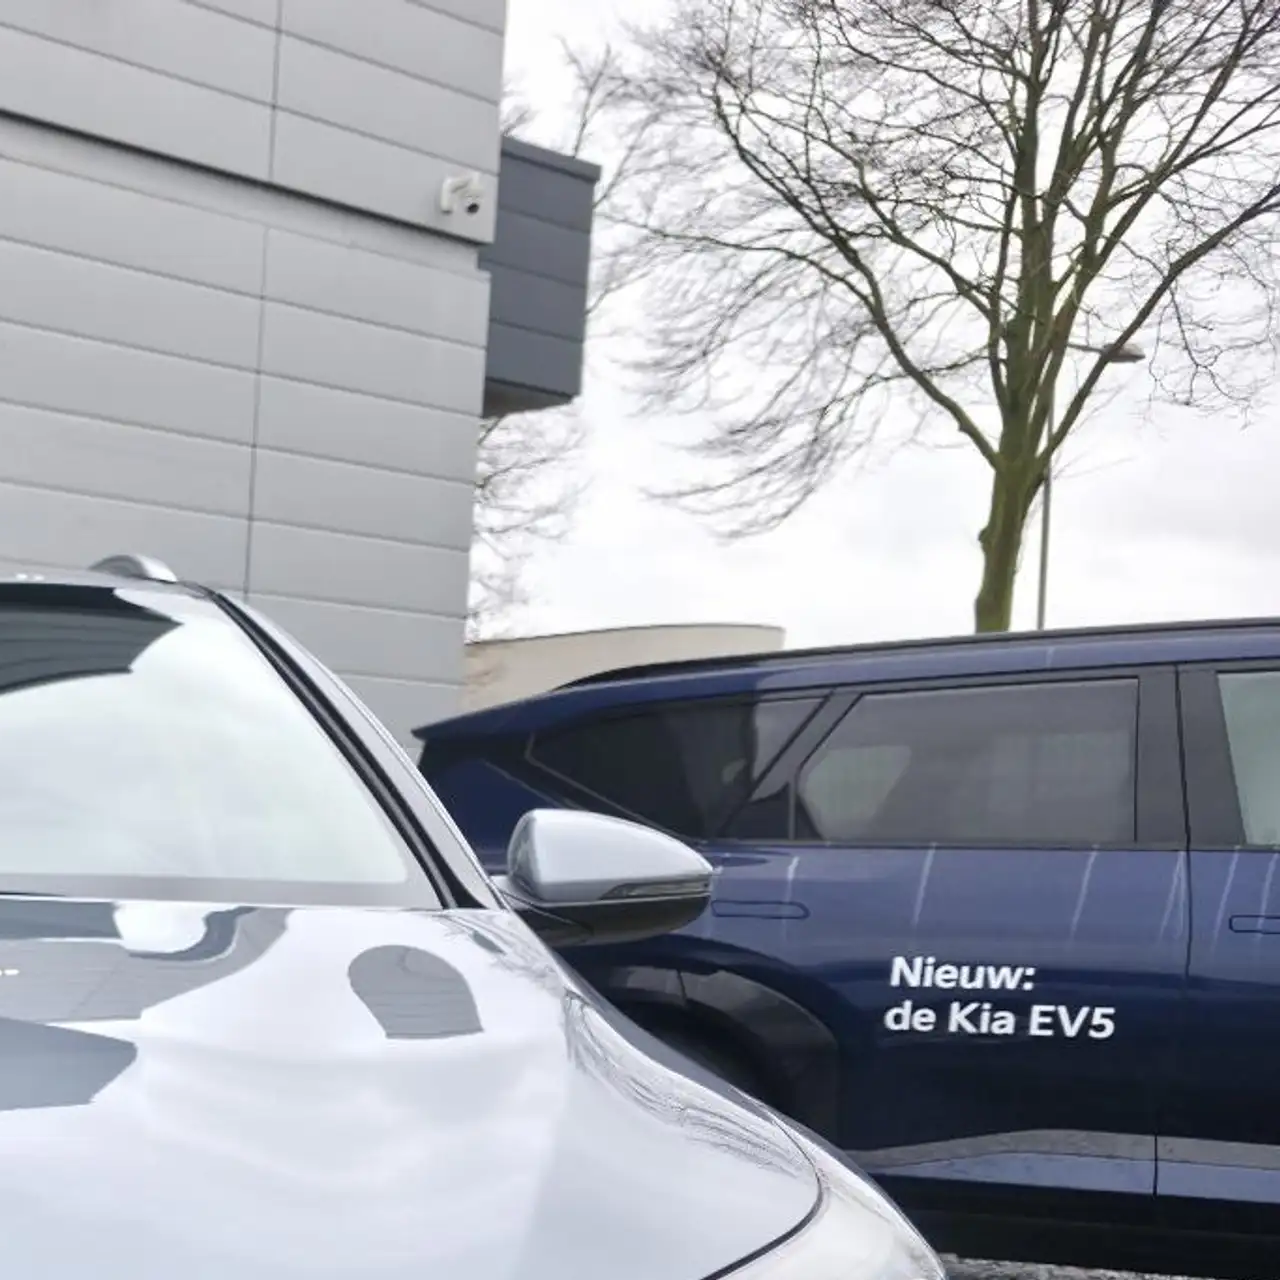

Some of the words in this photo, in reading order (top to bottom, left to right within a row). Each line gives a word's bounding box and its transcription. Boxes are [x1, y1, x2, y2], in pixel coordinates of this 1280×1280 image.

[890, 956, 1036, 991] Nieuw:
[884, 1000, 937, 1032] de
[948, 1001, 1016, 1034] Kia
[1028, 1004, 1116, 1039] EV5
